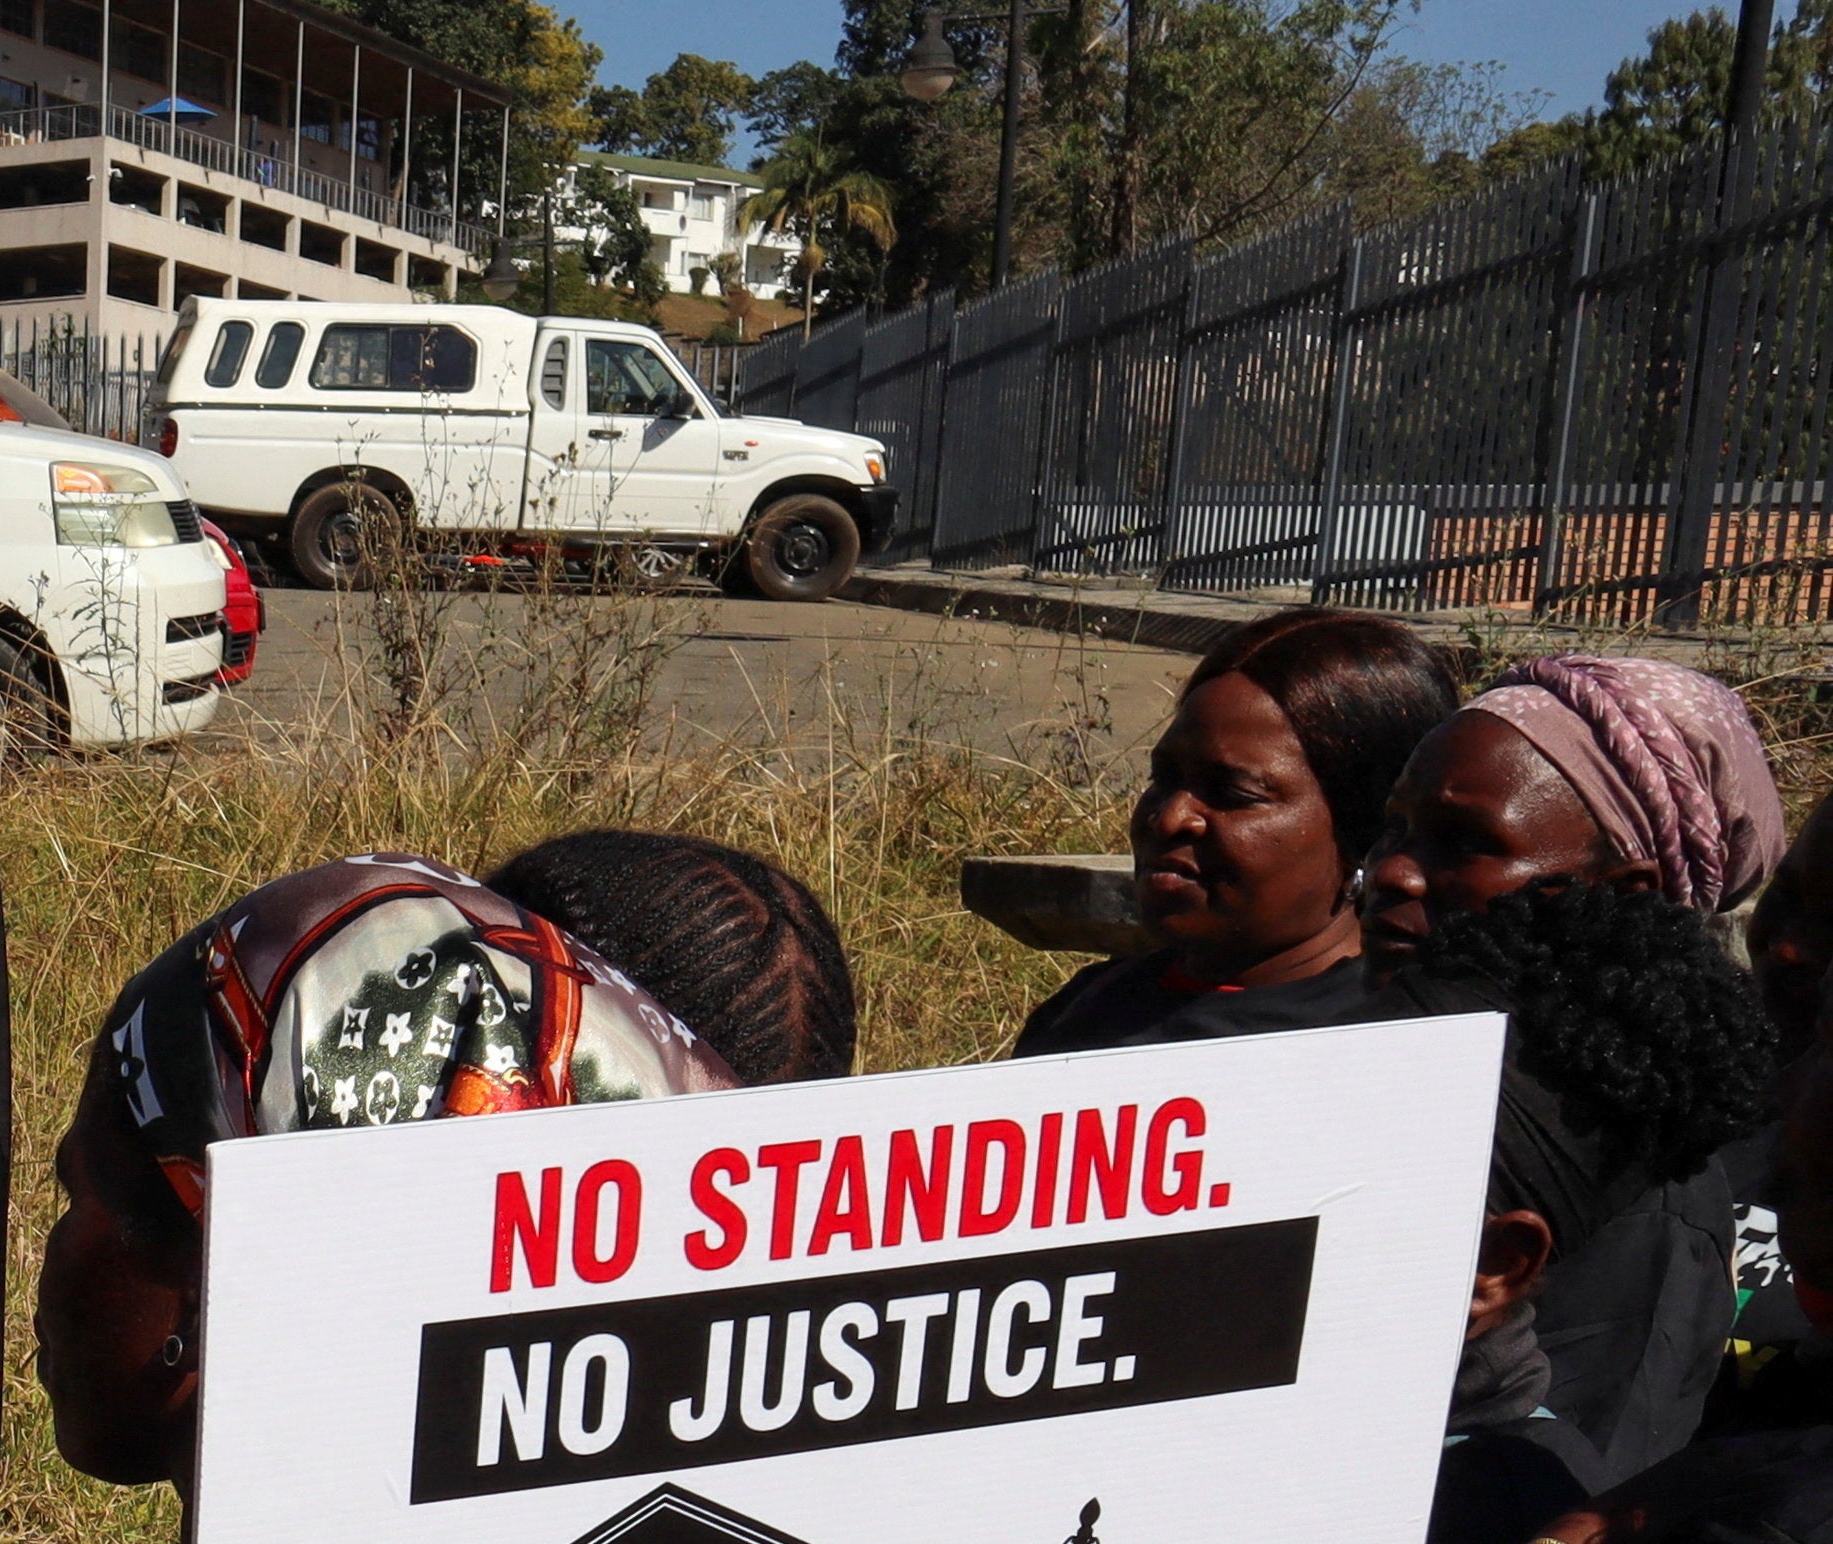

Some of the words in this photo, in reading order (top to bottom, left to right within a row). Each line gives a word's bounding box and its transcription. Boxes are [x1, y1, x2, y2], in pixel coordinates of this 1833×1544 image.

[490, 1159, 642, 1293] NO
[684, 1096, 1231, 1271] STANDING.
[476, 1333, 631, 1467] NO
[669, 1271, 1136, 1442] JUSTICE.
